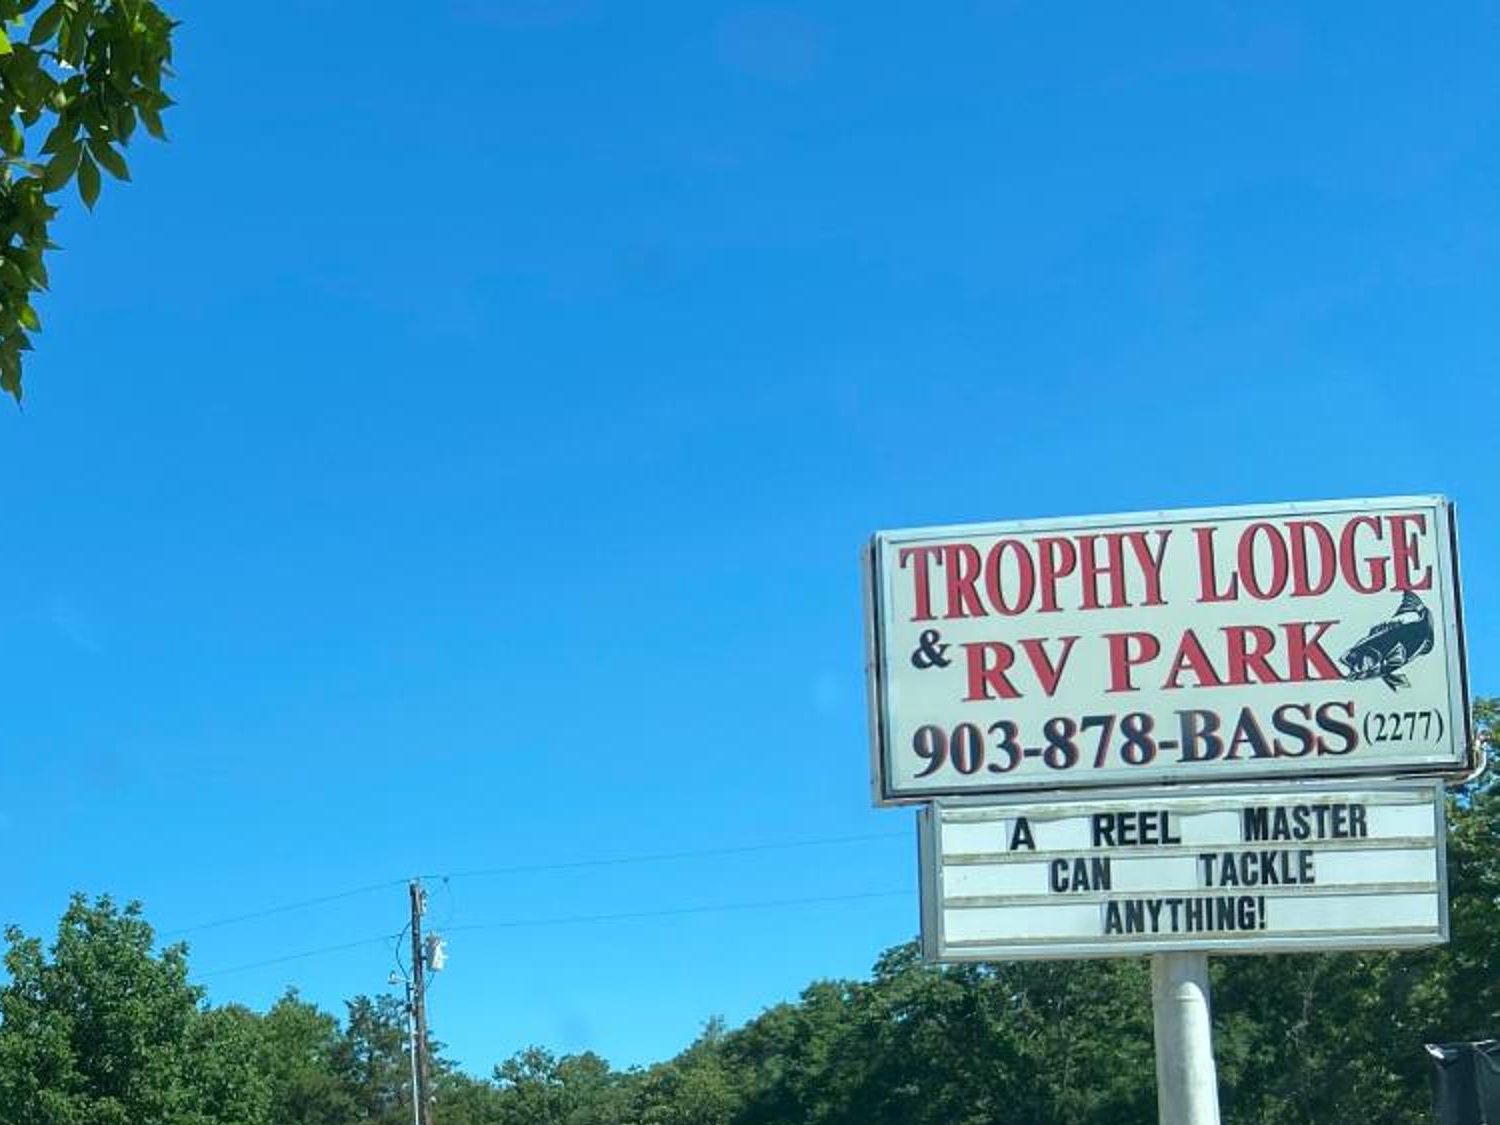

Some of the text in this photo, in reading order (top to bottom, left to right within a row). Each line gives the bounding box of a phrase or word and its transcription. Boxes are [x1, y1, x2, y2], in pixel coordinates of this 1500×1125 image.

[899, 513, 1432, 622] TROPHY LODGE
[911, 620, 1346, 702] & RV PARK
[912, 701, 1445, 778] 903-878-BASS (2277)
[1009, 803, 1368, 850] A REEL MASTER
[1051, 850, 1316, 892] CAN TACKLE
[1104, 895, 1266, 935] ANYTHING!
